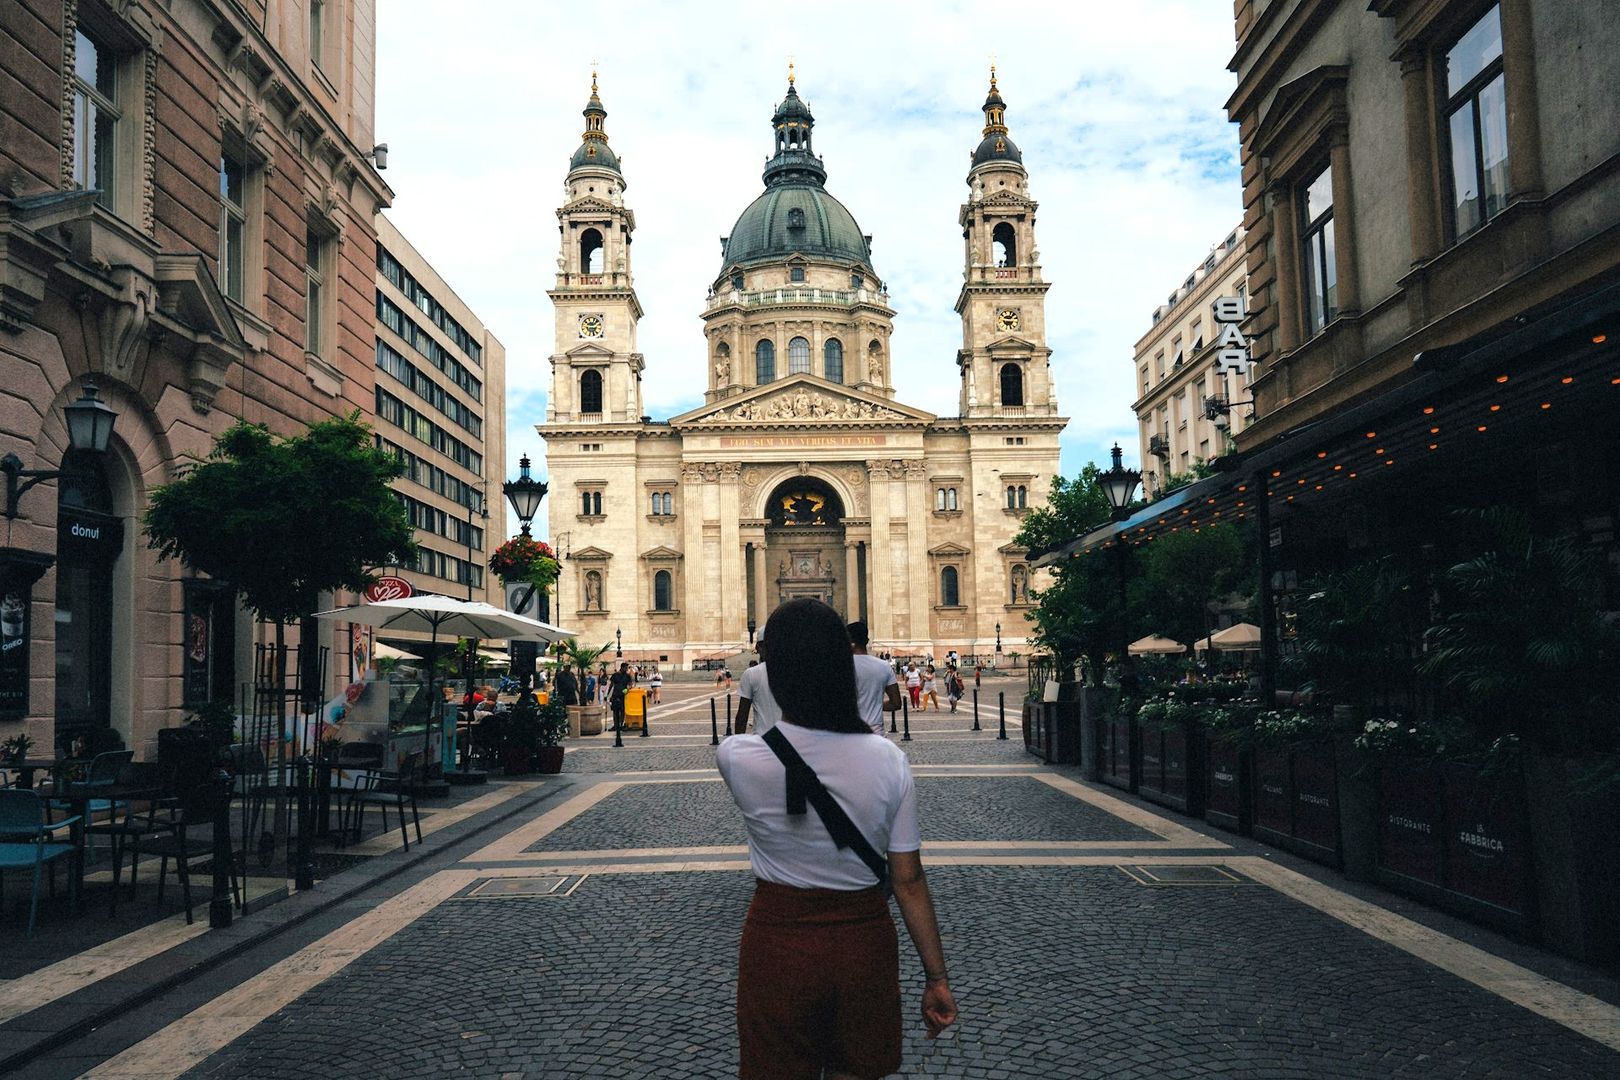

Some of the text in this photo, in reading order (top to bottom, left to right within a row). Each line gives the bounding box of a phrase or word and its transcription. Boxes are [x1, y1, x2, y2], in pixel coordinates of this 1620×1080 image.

[753, 438, 774, 447] SUM
[71, 523, 99, 540] donut
[2, 638, 23, 651] OREO
[1389, 814, 1431, 835] RISTORANTE
[1460, 831, 1504, 852] FABBRICA
